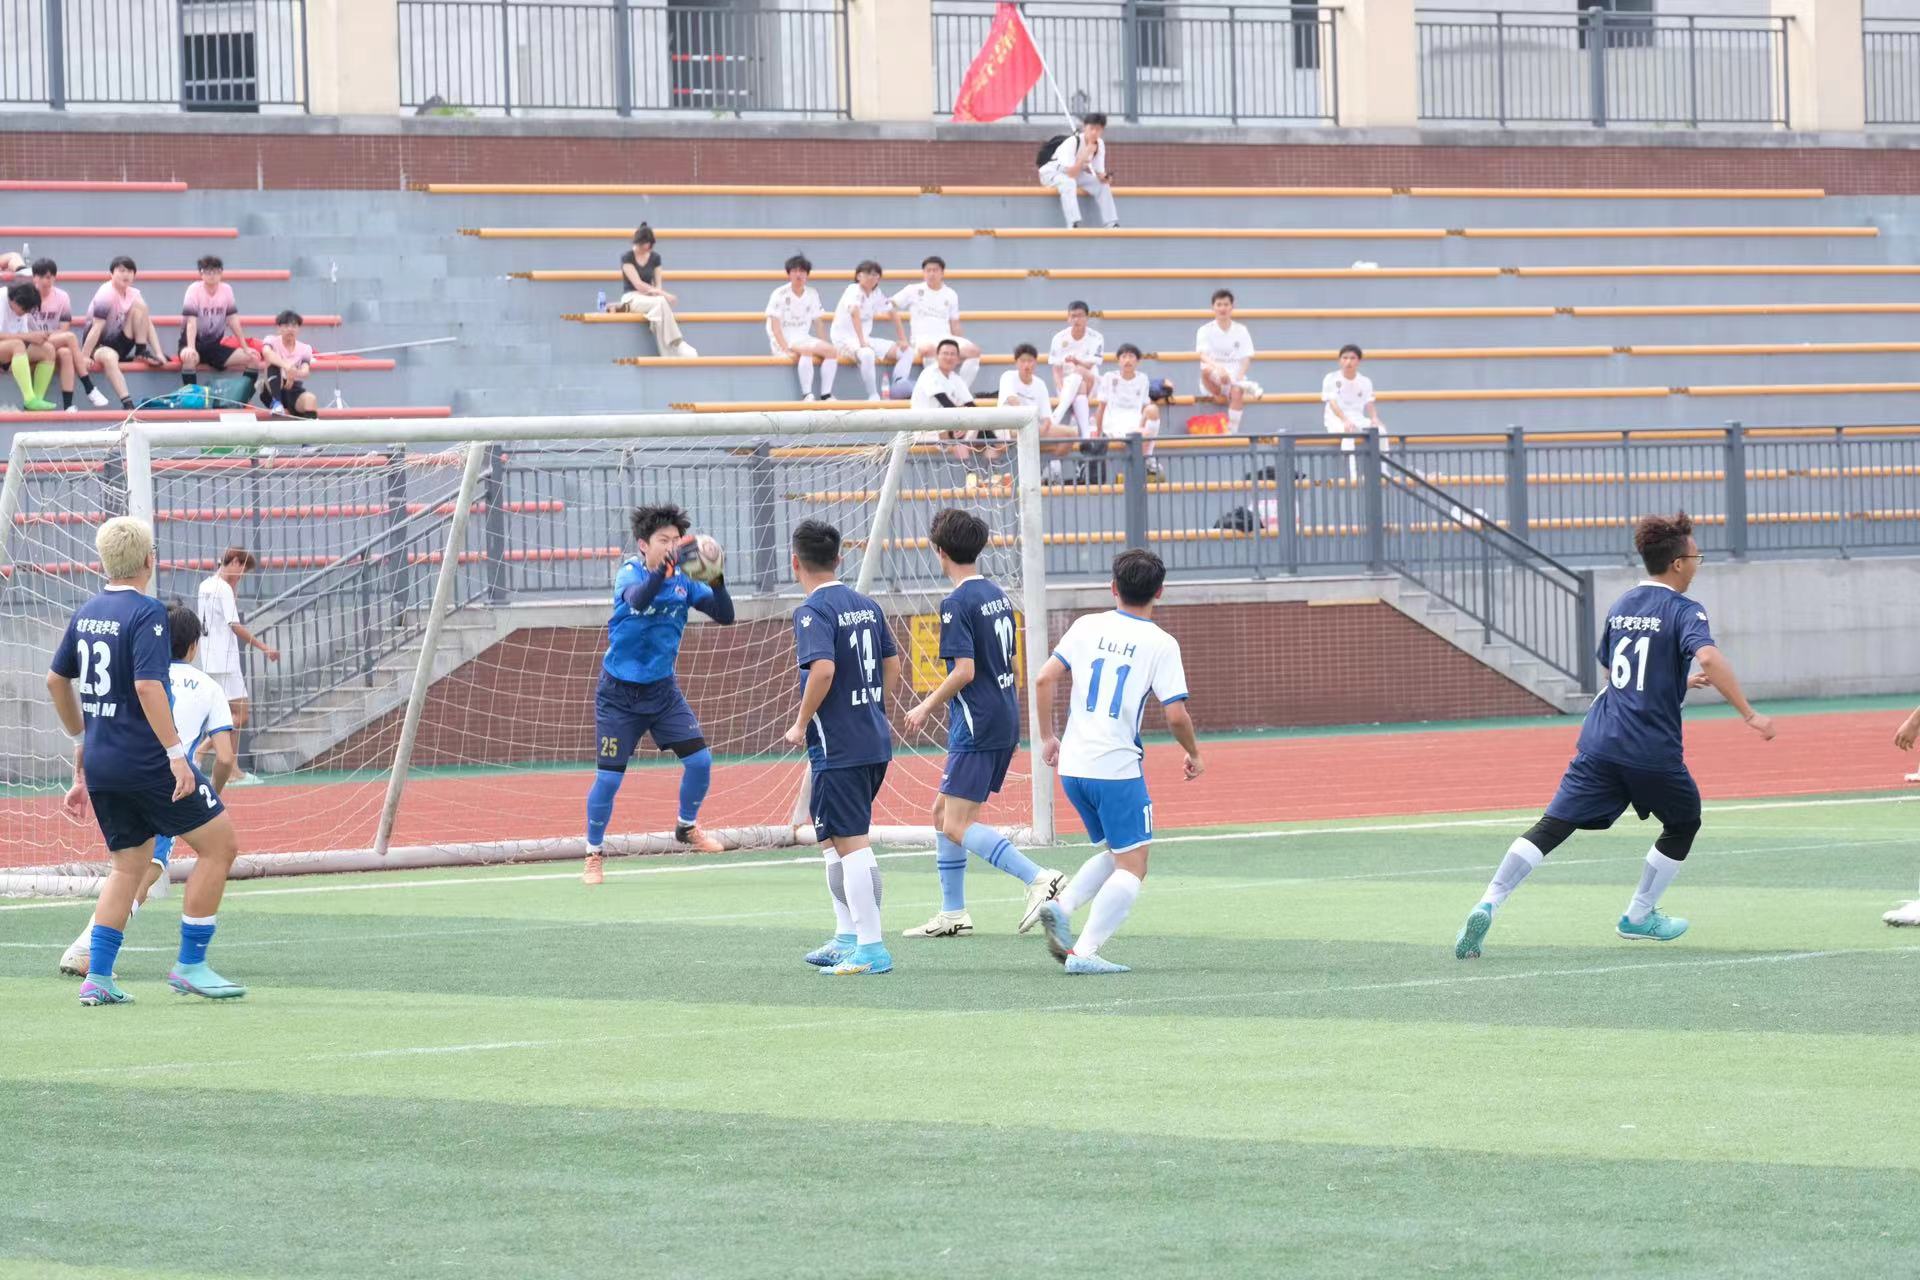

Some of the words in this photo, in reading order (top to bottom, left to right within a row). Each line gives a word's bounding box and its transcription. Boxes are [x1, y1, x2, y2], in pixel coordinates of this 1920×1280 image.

[77, 638, 111, 697] 23
[849, 629, 876, 683] 14
[1098, 636, 1136, 658] Lu.H
[1610, 636, 1650, 692] 61
[1086, 657, 1131, 720] 11
[600, 736, 618, 757] 25
[199, 784, 217, 809] 2
